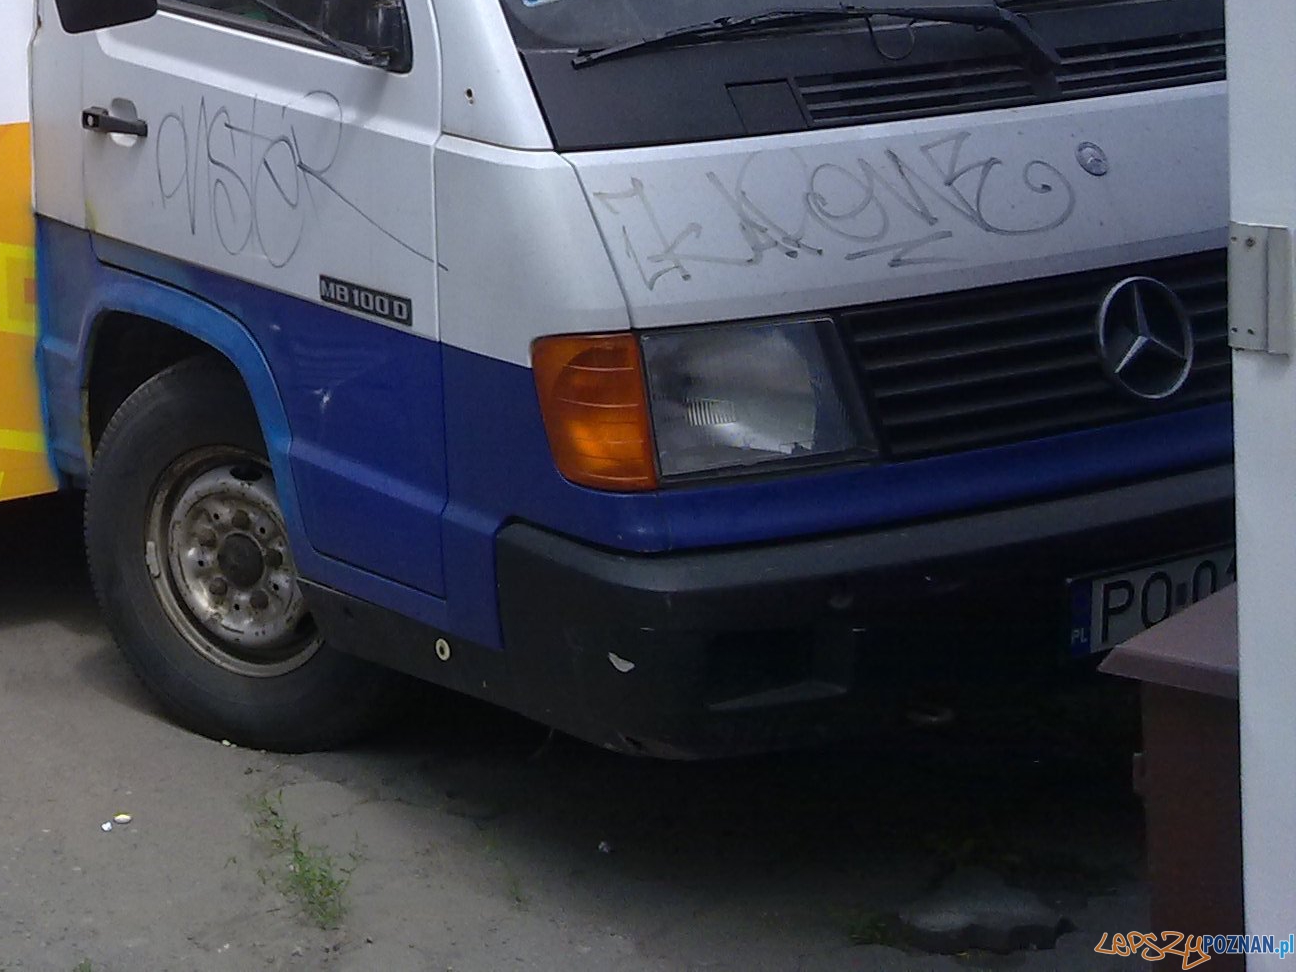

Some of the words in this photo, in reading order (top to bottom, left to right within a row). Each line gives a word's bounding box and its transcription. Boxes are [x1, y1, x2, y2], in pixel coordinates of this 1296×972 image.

[320, 277, 350, 305] MB
[353, 284, 390, 315] 100
[393, 298, 409, 321] D
[1070, 630, 1088, 645] PL
